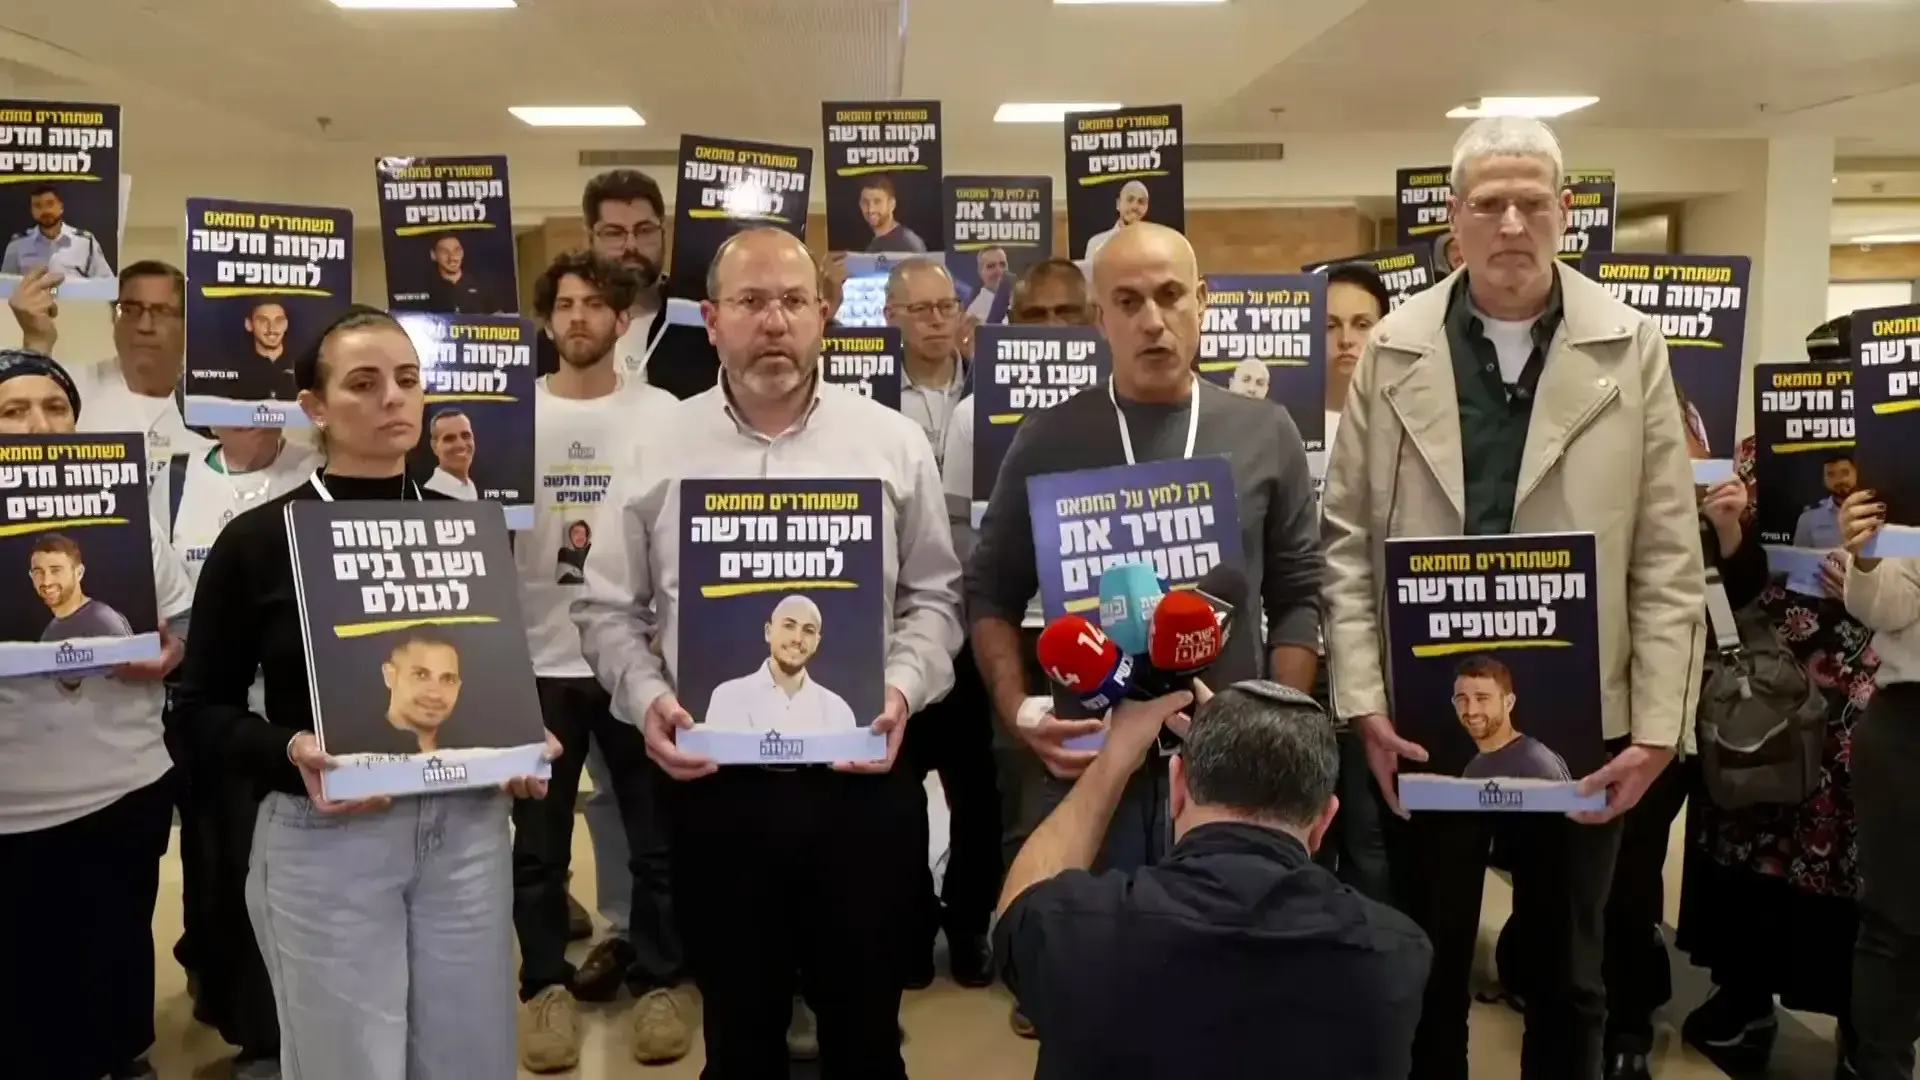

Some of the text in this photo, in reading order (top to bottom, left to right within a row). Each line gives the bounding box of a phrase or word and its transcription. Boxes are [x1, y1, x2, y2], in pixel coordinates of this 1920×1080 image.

[0, 108, 104, 125] משתחררים מחמא
[836, 109, 928, 122] משתחררים מחמאס
[1078, 114, 1170, 132] משתחררים מחמאס
[0, 125, 113, 150] תקווה חדש
[828, 123, 937, 145] תקווה חדשה
[1070, 128, 1178, 152] תקווה חדשה
[0, 151, 92, 173] לחטופים
[695, 146, 798, 169] משתחררים מחמאס
[846, 144, 920, 165] לחטופים
[1088, 149, 1161, 174] לחטופים
[434, 164, 493, 178] משתחררים
[684, 160, 806, 193] תקווה חדשה
[1409, 173, 1444, 187] מחמאס
[383, 179, 504, 201] תקווה חדשה
[1401, 186, 1451, 205] חדשה
[203, 211, 335, 234] משתחררים מחמאס
[405, 200, 487, 224] לחטופים
[954, 200, 1041, 221] יחזיר את
[1566, 207, 1609, 230] תקוו
[954, 221, 1041, 241] החטופים
[191, 228, 345, 262] תקווה חדשה
[216, 260, 322, 287] לחטופים
[1374, 252, 1416, 272] משתחר
[1599, 264, 1732, 284] משתחררים מחמאס
[1379, 266, 1427, 292] תקוו
[1247, 288, 1263, 304] על
[1266, 289, 1291, 306] לחץ
[1293, 290, 1310, 306] רק
[1604, 282, 1742, 313] תקווה חדש
[1200, 307, 1311, 332] יחזיר את
[1872, 316, 1920, 337] חמאס
[451, 325, 520, 341] משתחררים
[463, 342, 531, 369] תקווה
[997, 340, 1096, 364] יש תקווה
[1200, 333, 1311, 358] החטופים
[1860, 337, 1920, 367] דשה
[830, 355, 895, 380] תקווה
[995, 363, 1097, 386] ושבו בנים
[422, 367, 508, 393] לחטופי
[1772, 372, 1823, 388] מחמאס
[1762, 389, 1834, 413] חדשה
[1786, 416, 1856, 440] טופים
[0, 443, 126, 462] משתחררים מחמא
[0, 465, 58, 490] חדש
[64, 462, 139, 489] תקווה
[583, 474, 612, 488] קווה
[6, 491, 118, 521] לחטופים
[704, 493, 860, 512] משתחררים מחמאס
[1056, 481, 1212, 518] רק לחץ על החמאס
[330, 519, 477, 551] יש תקווה
[691, 515, 873, 546] תקווה חדשה
[1060, 505, 1215, 557] יחזיר את
[332, 551, 487, 581] ושבו בנים
[719, 547, 844, 579] לחטופים
[1409, 550, 1571, 573] משתחררים מחמאס
[360, 579, 470, 614] לגבולם
[1397, 573, 1586, 605] תקווה חדשה
[1428, 604, 1557, 639] לחטופים
